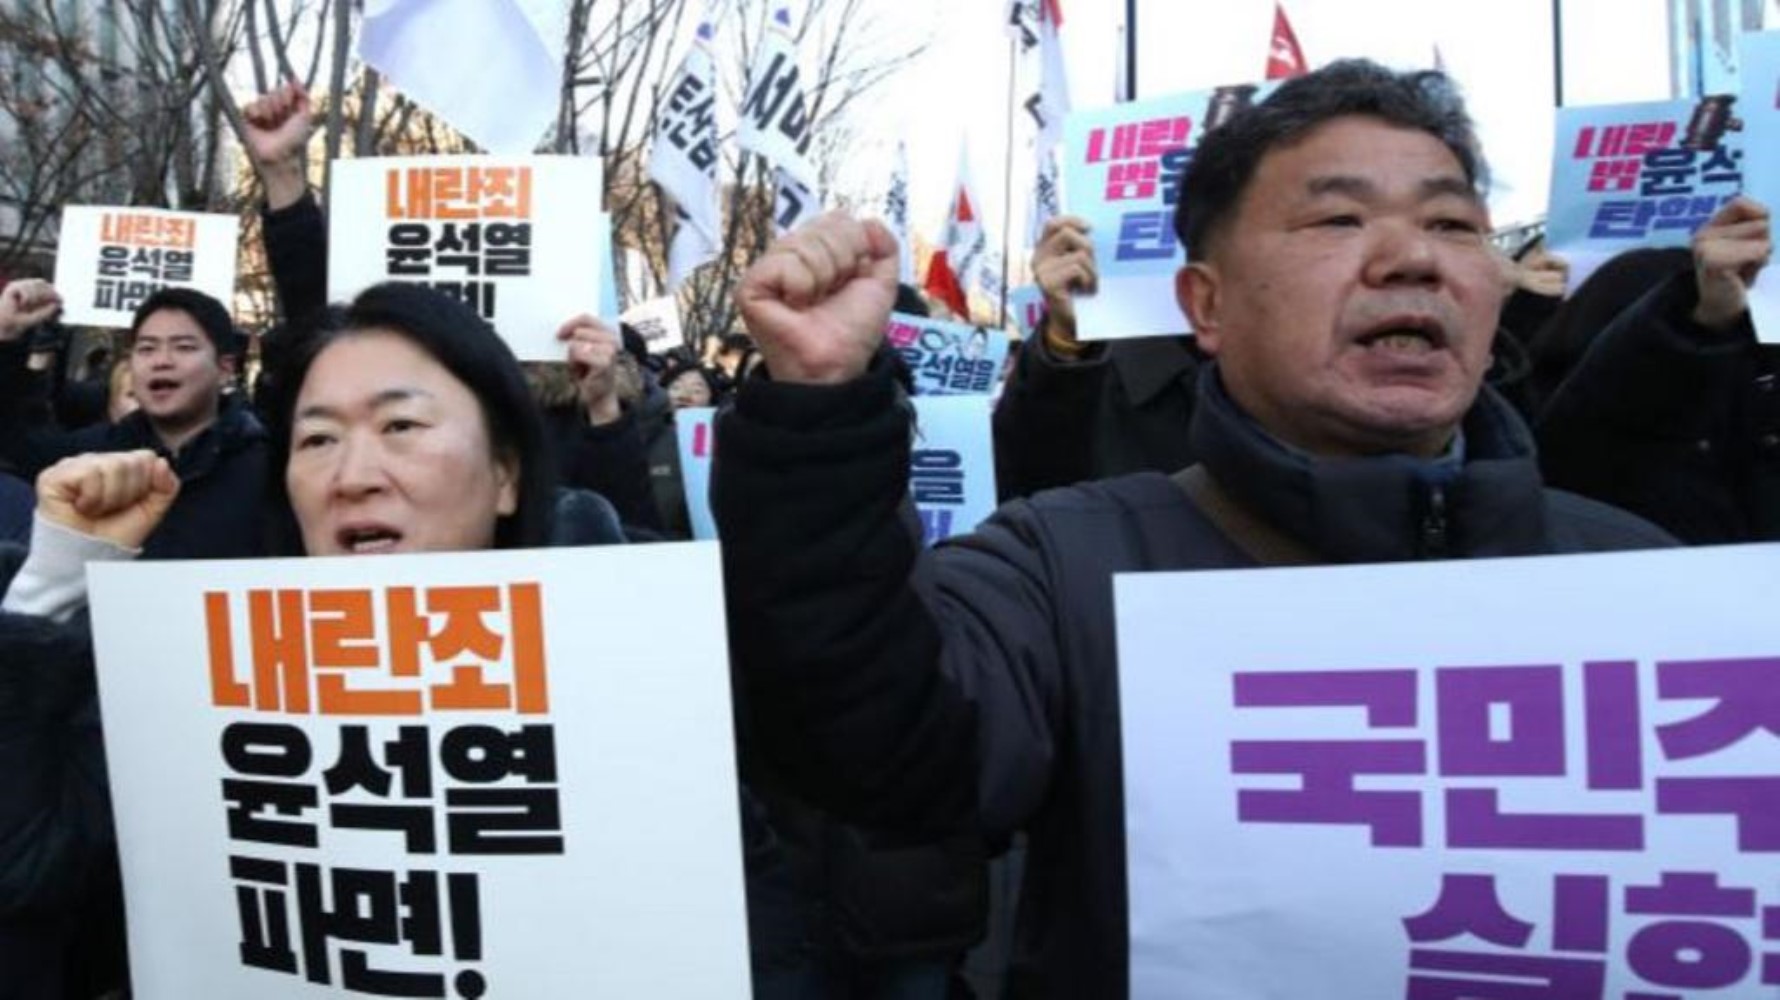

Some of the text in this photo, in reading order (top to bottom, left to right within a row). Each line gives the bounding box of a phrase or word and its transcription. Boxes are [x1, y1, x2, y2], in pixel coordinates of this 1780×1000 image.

[387, 167, 532, 219] 내란죄
[1588, 194, 1742, 239] 탄핵
[101, 213, 196, 247] 내란죄
[387, 223, 531, 275] 윤석열
[98, 246, 194, 281] 윤석열
[94, 279, 167, 311] 파면
[204, 582, 549, 716] 내란죄
[1230, 656, 1780, 852] 국민주
[220, 721, 565, 855] 윤석열
[229, 855, 487, 1000] 파면!
